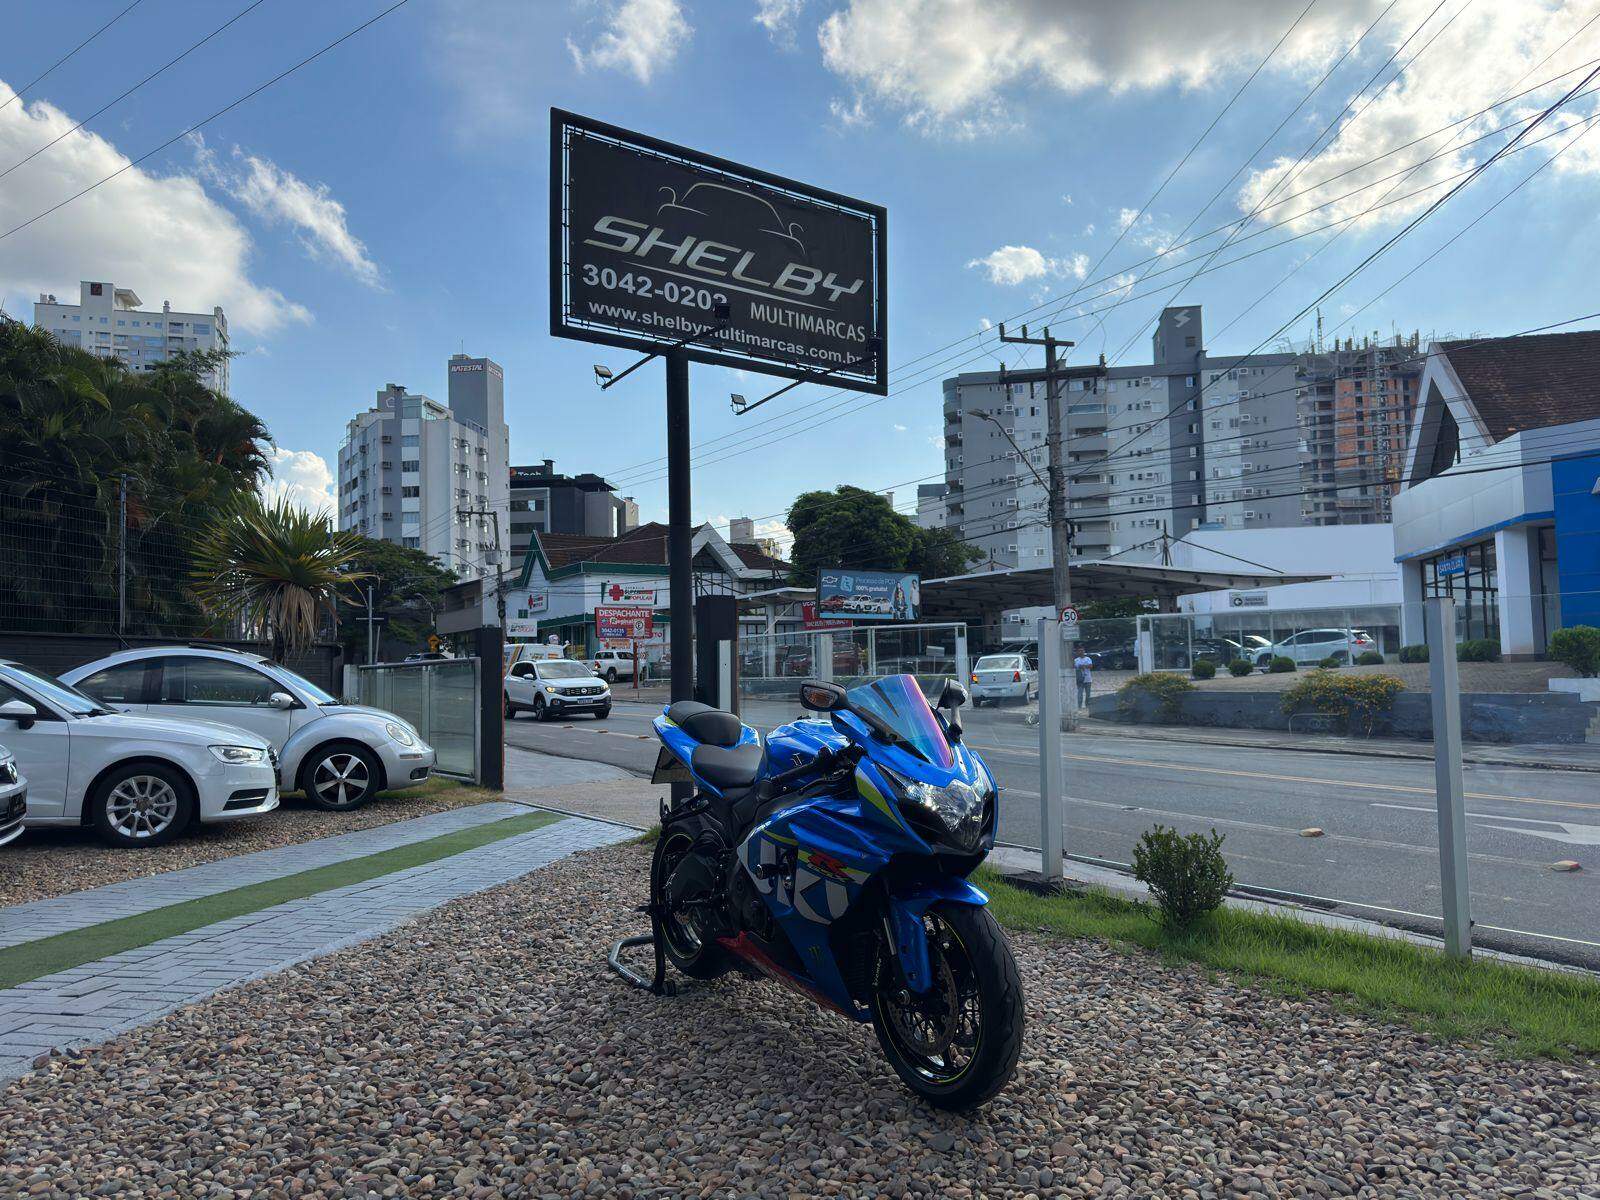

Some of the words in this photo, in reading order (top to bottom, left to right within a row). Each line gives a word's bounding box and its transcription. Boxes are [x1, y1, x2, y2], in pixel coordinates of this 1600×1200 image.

[583, 215, 864, 302] SHELBY
[750, 302, 866, 343] MULTIMARCAS
[599, 609, 650, 618] DESPACHANTE
[1064, 611, 1076, 621] 50
